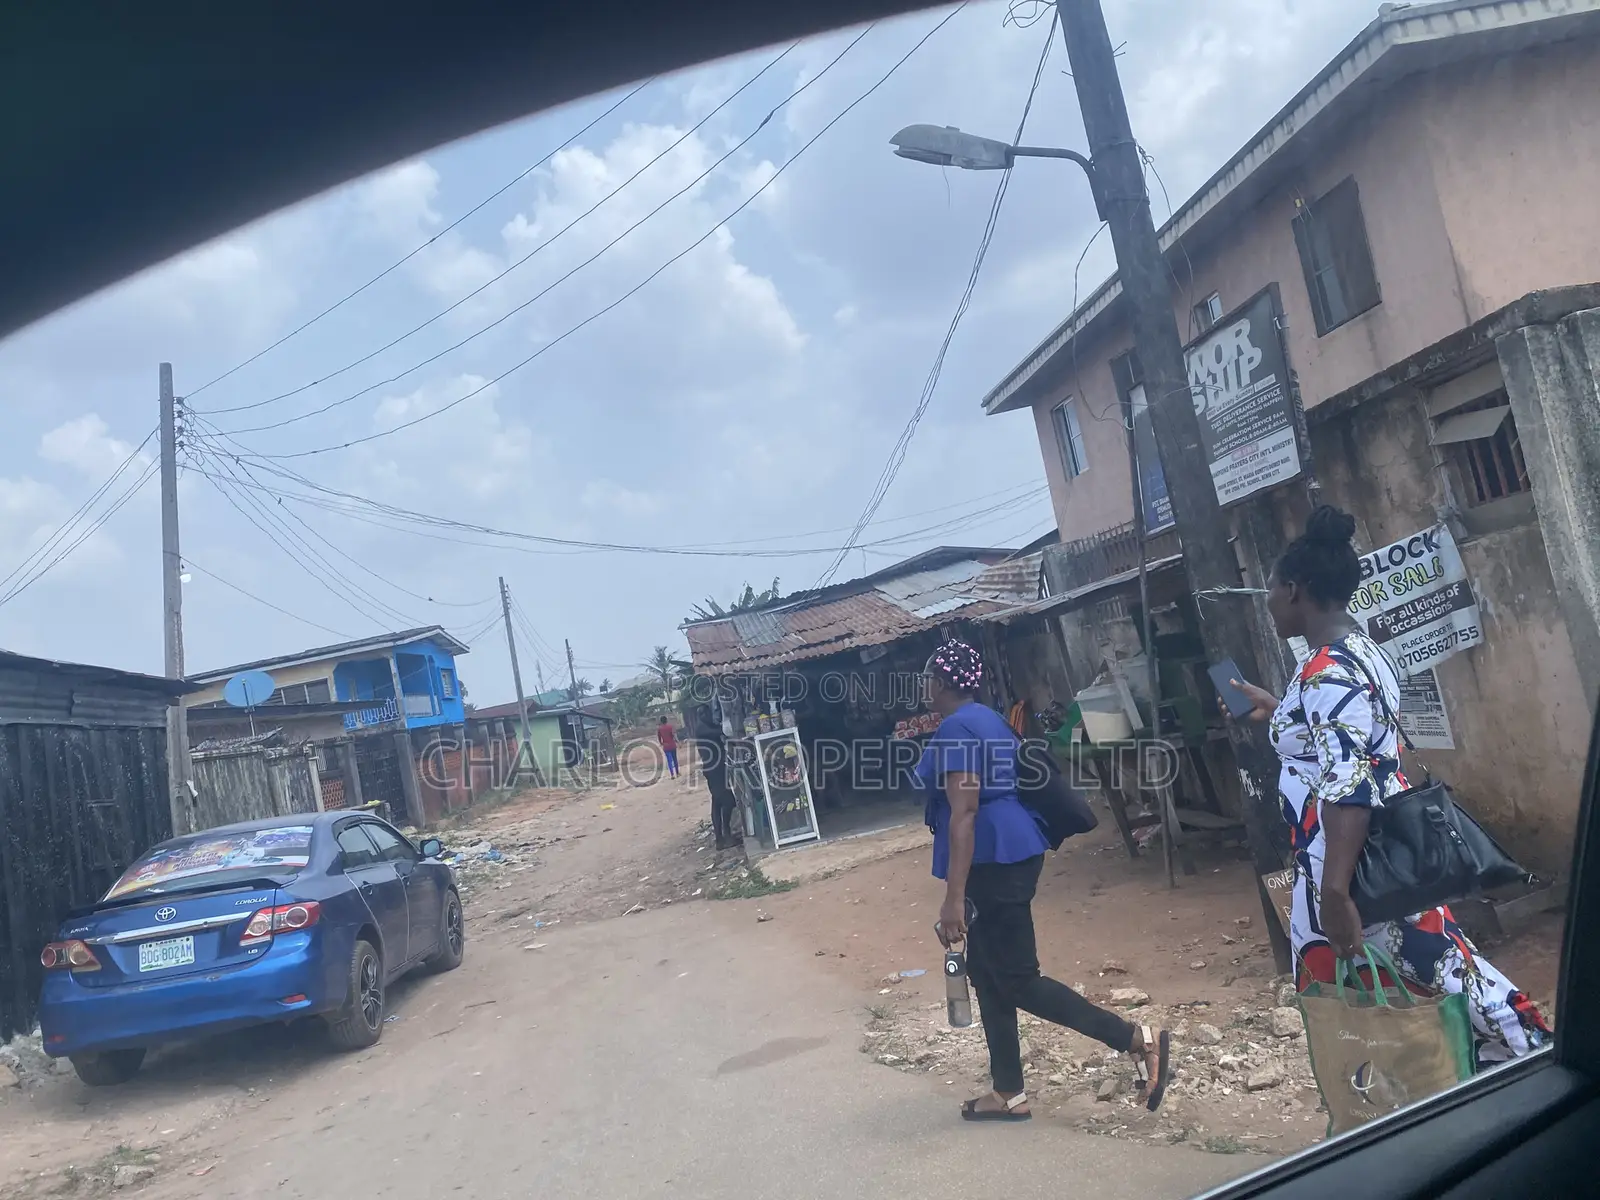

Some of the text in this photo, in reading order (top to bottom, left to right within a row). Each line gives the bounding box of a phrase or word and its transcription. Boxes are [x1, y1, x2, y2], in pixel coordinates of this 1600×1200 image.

[1223, 401, 1256, 423] DELIVERANCE
[1256, 388, 1281, 404] SERVICE
[1238, 405, 1262, 420] SOMETHING
[1222, 426, 1252, 444] CELEBRATION
[1252, 416, 1272, 430] SERVICE
[1229, 436, 1248, 449] SCHOOL
[1229, 458, 1248, 470] PRAYERS
[1248, 453, 1260, 462] CITY
[1358, 529, 1440, 582] BLOCK
[1348, 580, 1388, 614] FOR
[1376, 612, 1398, 629] For
[1399, 603, 1415, 620] all
[1416, 592, 1446, 615] kinds
[1390, 602, 1453, 635] occassions
[1401, 636, 1424, 650] PLACE
[235, 896, 267, 906] COROLLA
